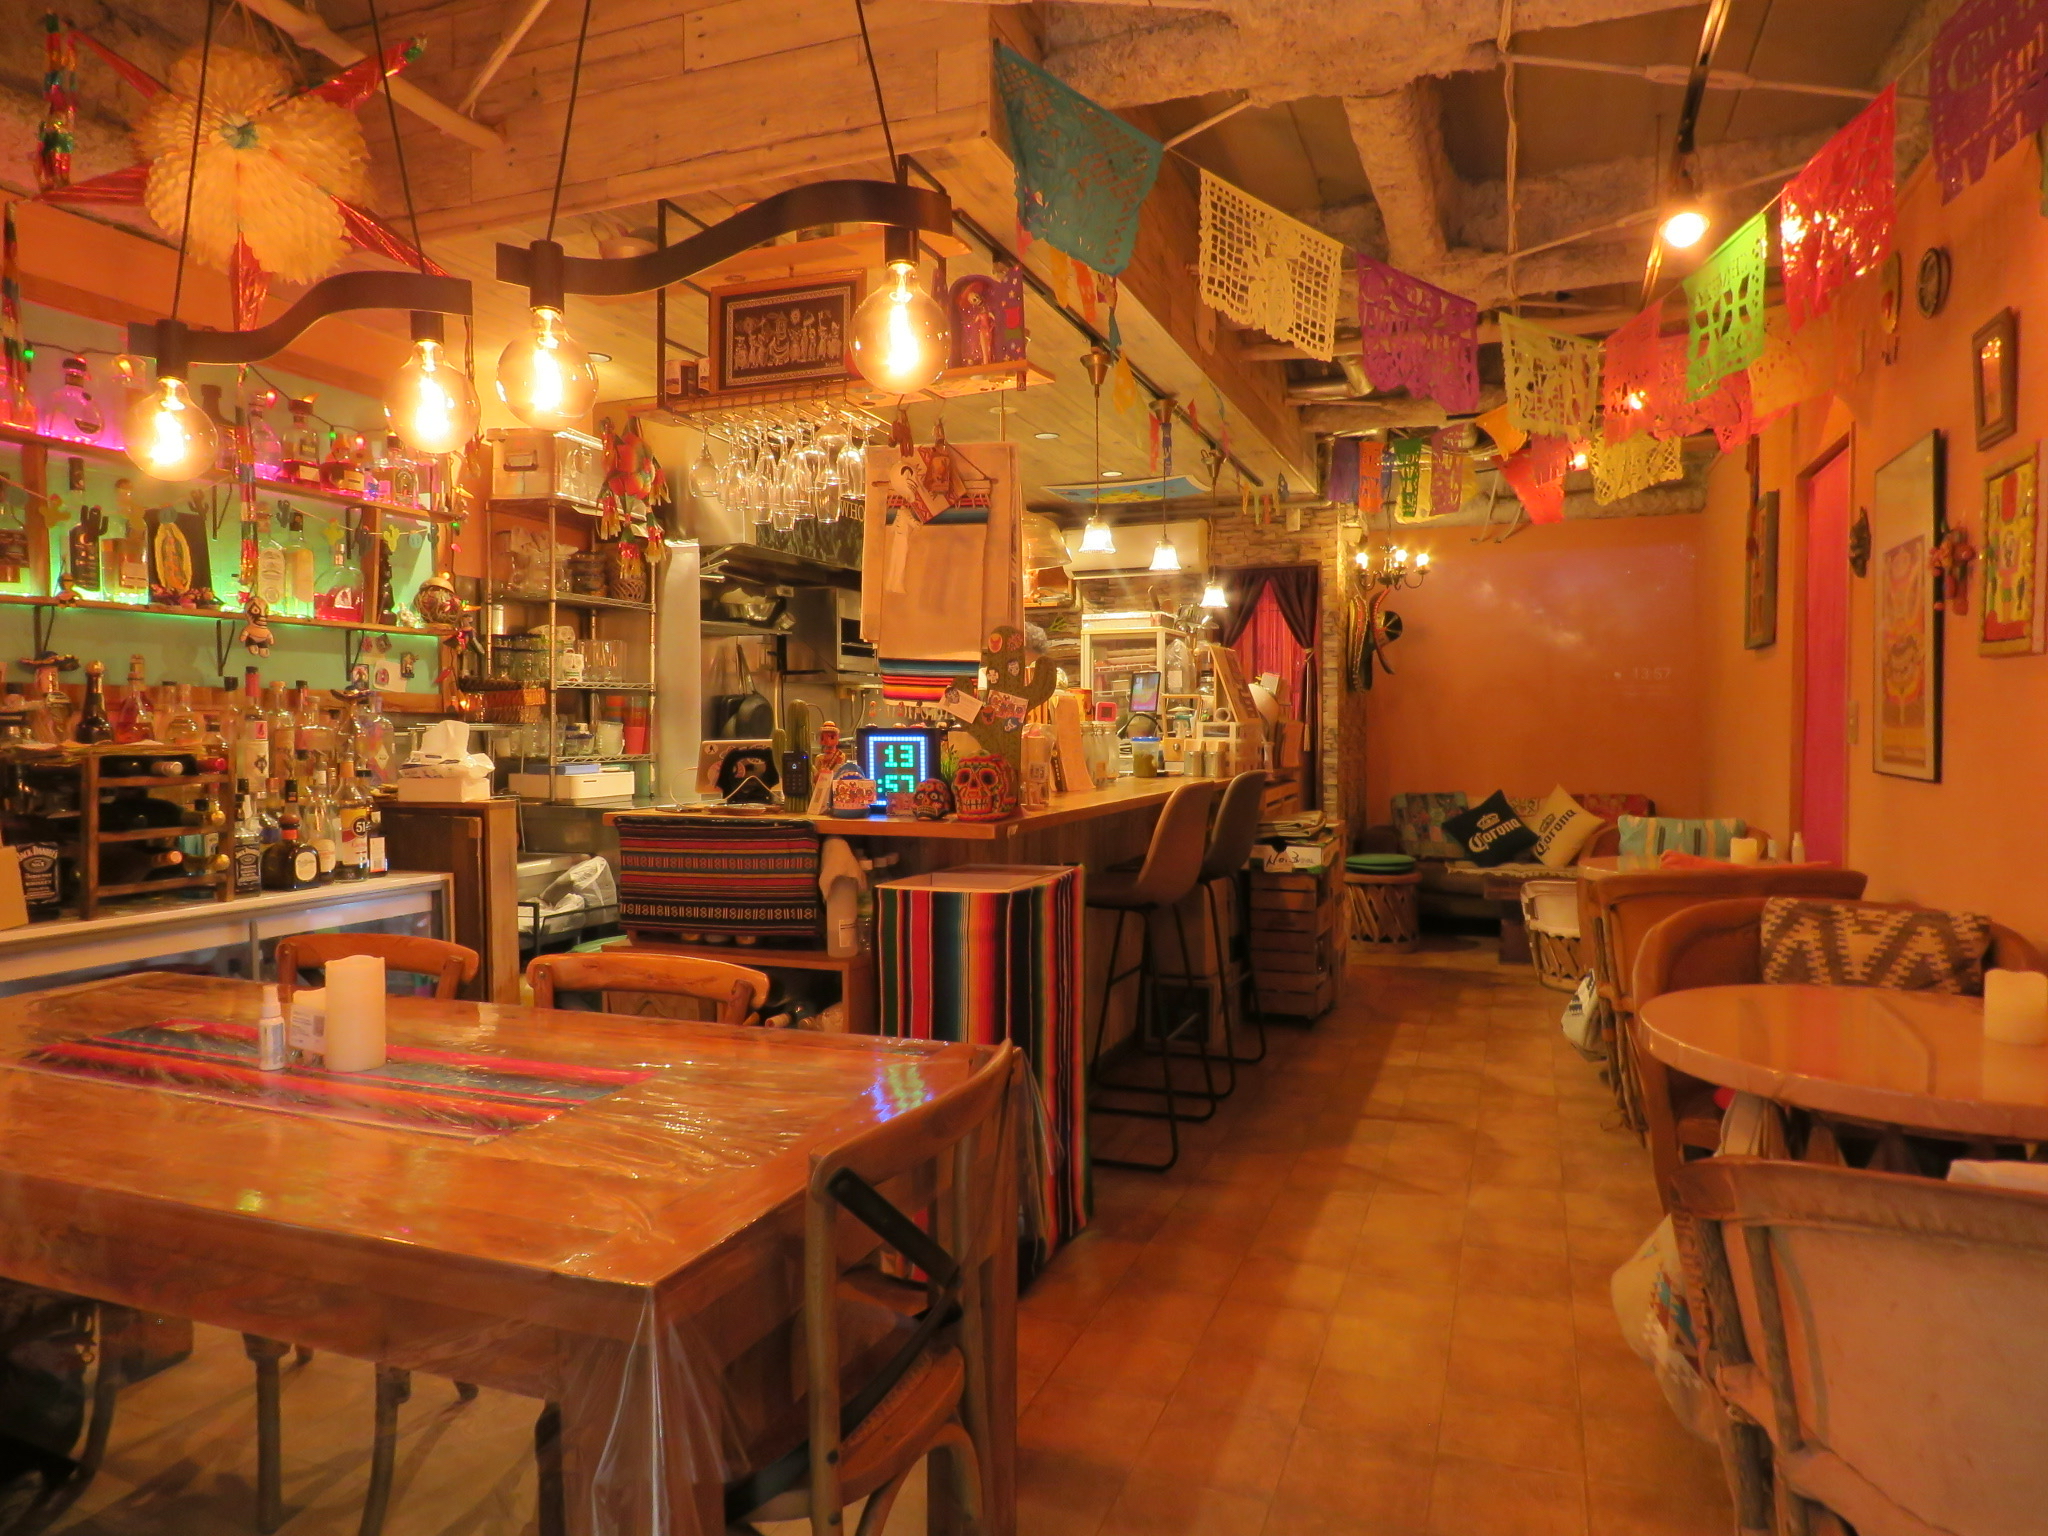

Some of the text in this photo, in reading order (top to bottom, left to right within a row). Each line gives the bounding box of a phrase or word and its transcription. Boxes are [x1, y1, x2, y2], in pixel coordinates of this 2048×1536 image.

[884, 744, 914, 768] 13
[1468, 818, 1522, 853] Corona
[1535, 808, 1577, 857] Corona
